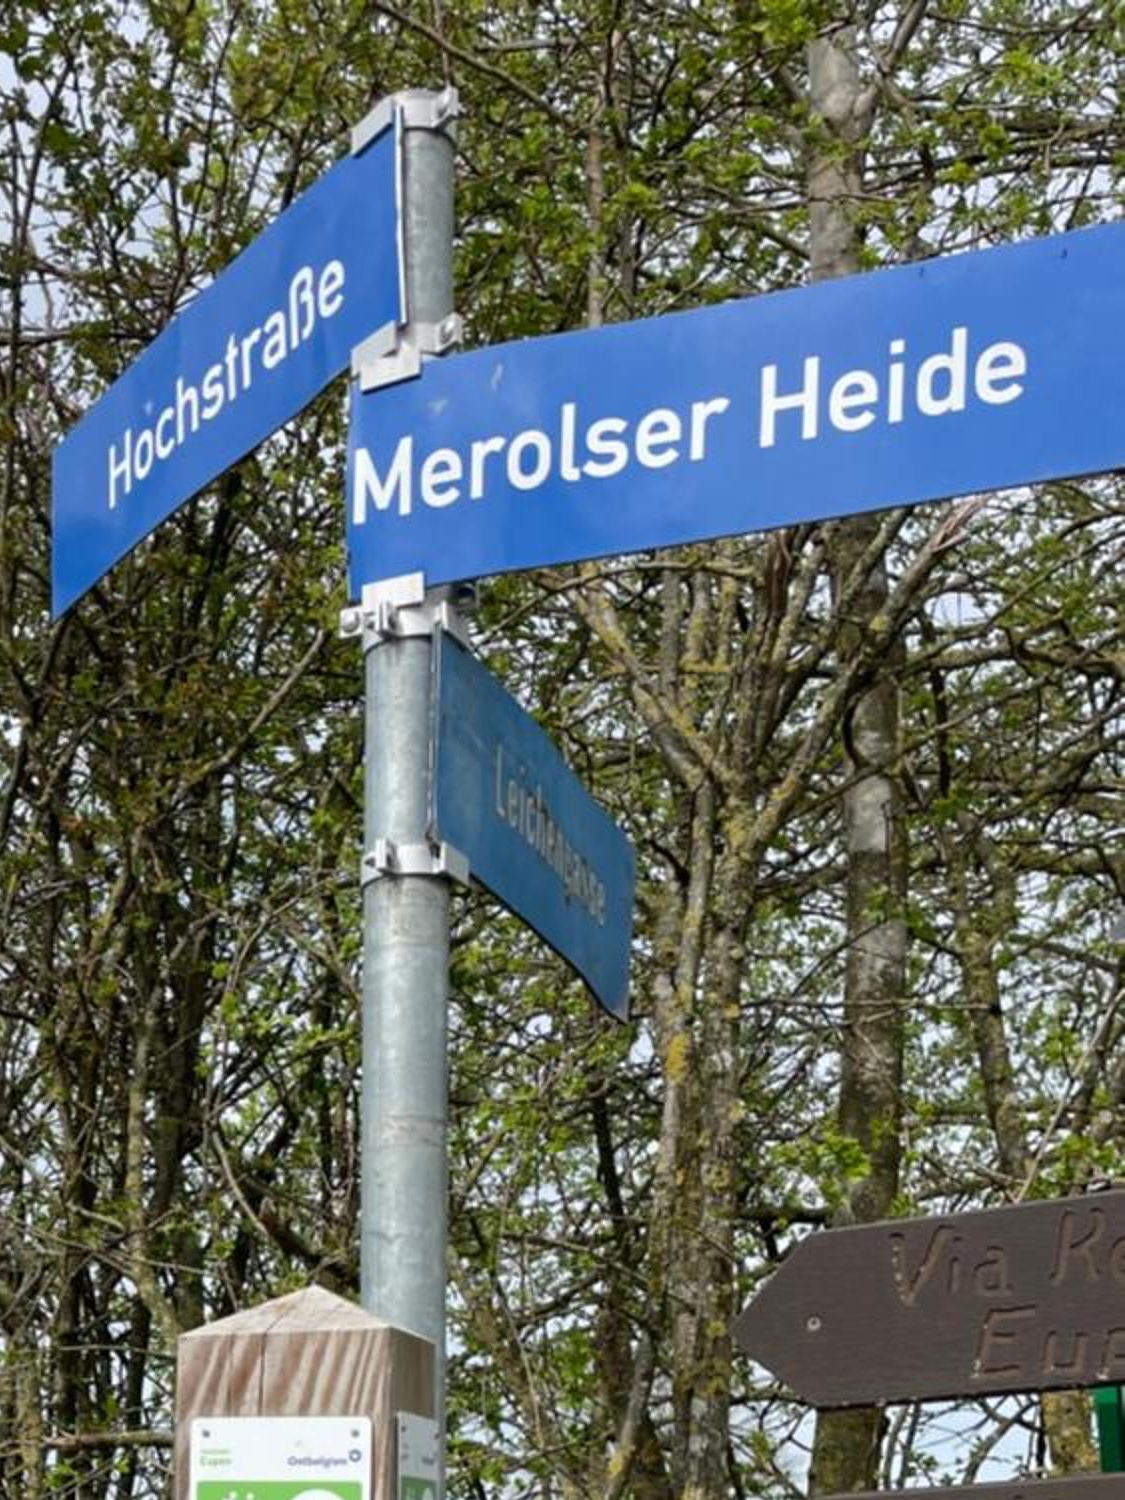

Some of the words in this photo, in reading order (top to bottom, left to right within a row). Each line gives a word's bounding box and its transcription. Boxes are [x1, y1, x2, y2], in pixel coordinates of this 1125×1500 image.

[108, 259, 345, 509] Hochstraße
[353, 396, 731, 525] Merolser
[758, 327, 1027, 448] Heide
[889, 1223, 1015, 1305] Via
